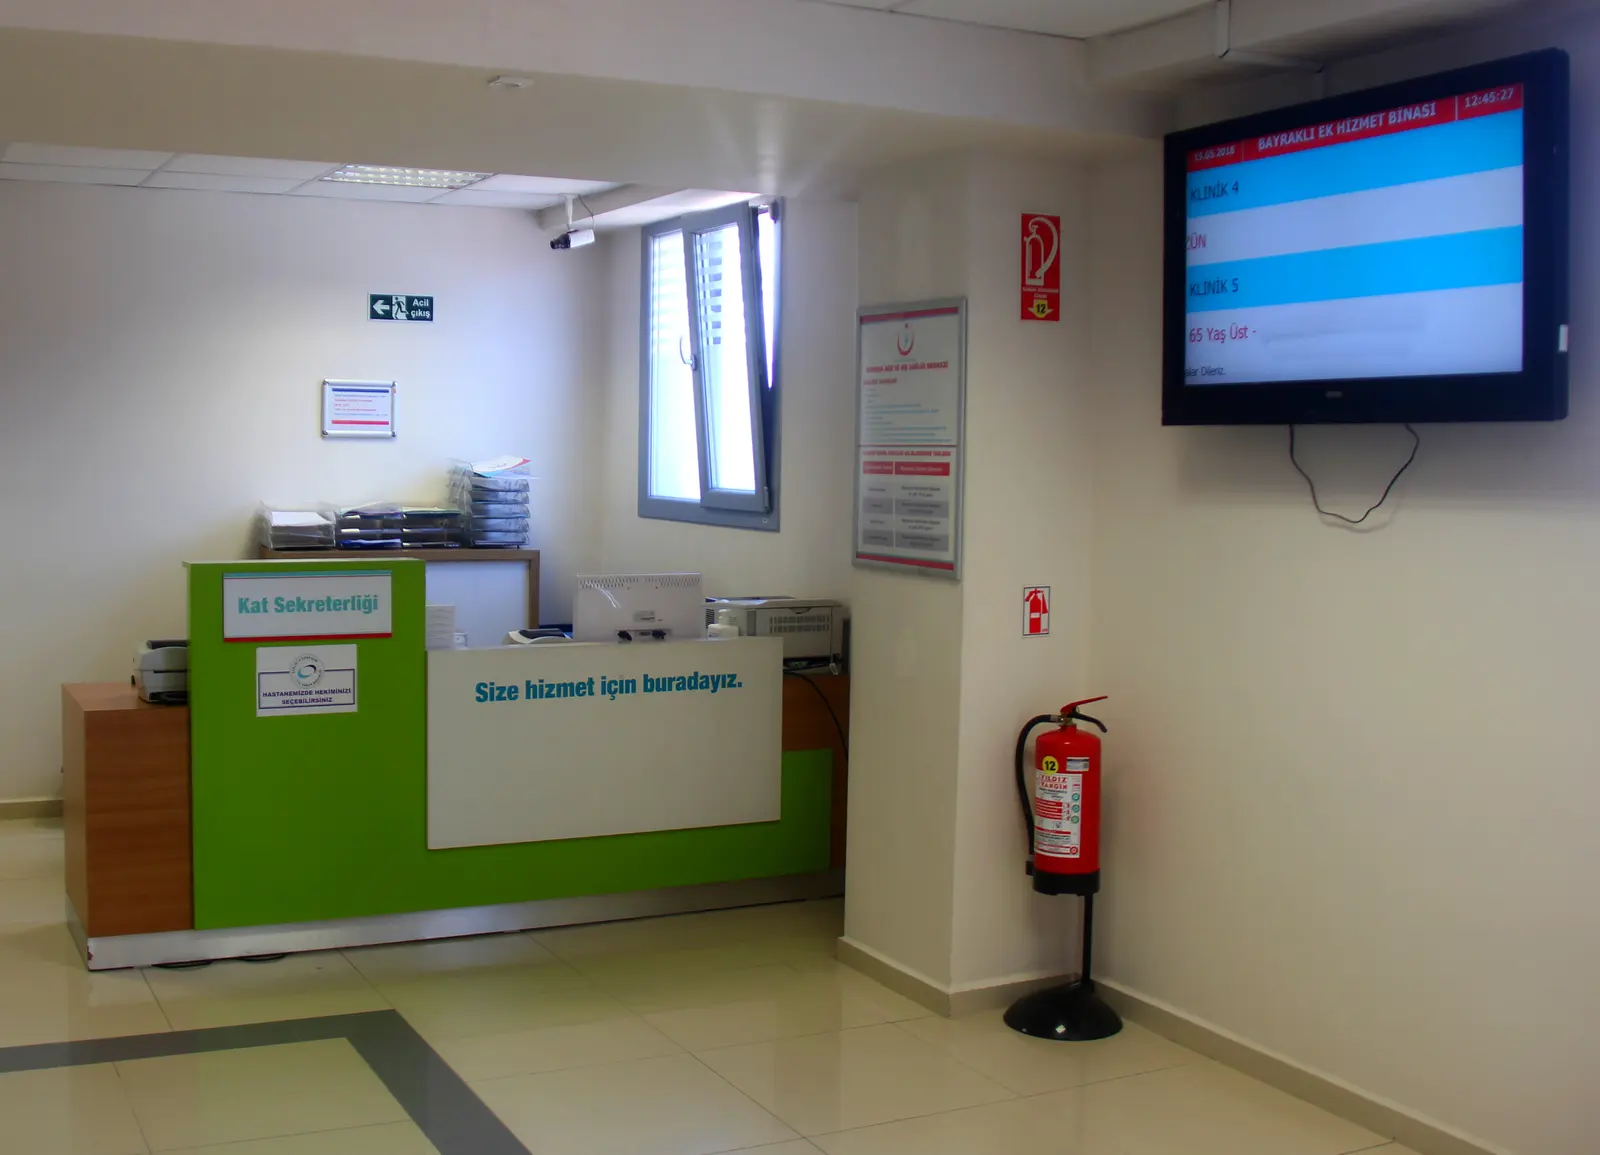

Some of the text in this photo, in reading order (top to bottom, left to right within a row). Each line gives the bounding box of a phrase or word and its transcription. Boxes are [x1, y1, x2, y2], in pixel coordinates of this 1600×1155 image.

[1258, 127, 1314, 150] BAYRAKLI
[1318, 125, 1333, 138] EK
[1336, 111, 1385, 135] HİZMET
[1464, 87, 1514, 108] 12:45:27
[1231, 181, 1239, 194] 4
[1231, 277, 1239, 292] 5
[412, 298, 429, 306] Acil
[1036, 303, 1046, 314] 12
[410, 308, 431, 318] çıkış
[1189, 328, 1203, 343] 65
[1207, 327, 1226, 344] Yaş
[1229, 323, 1249, 340] Üst
[238, 594, 379, 614] Kat Sekreterliği
[475, 681, 519, 703] Size
[525, 677, 595, 700] hizmet
[643, 671, 743, 693] buradayız.
[1044, 760, 1056, 771] 12
